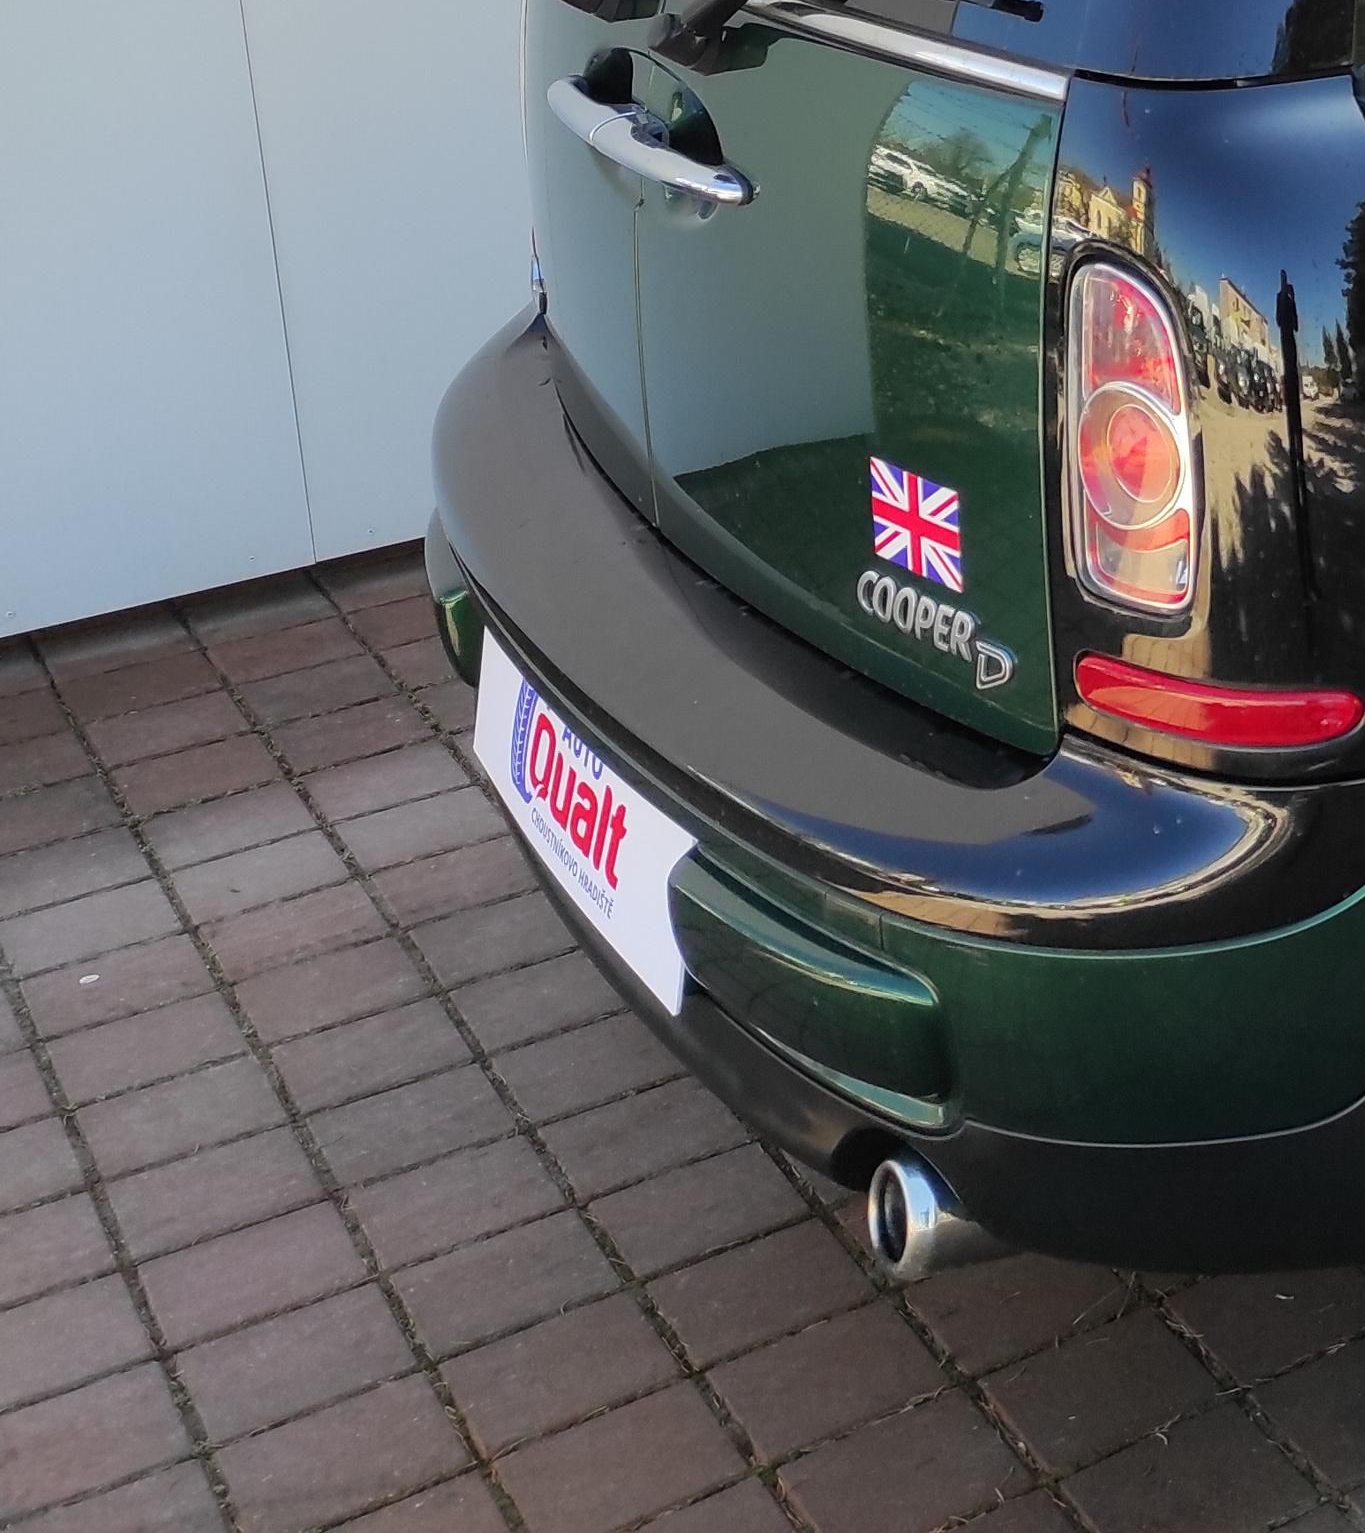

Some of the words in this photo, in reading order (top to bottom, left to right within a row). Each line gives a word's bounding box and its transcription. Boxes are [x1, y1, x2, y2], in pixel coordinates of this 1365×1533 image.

[856, 570, 976, 662] COOPER
[974, 640, 1016, 690] D
[529, 712, 627, 891] Qualt
